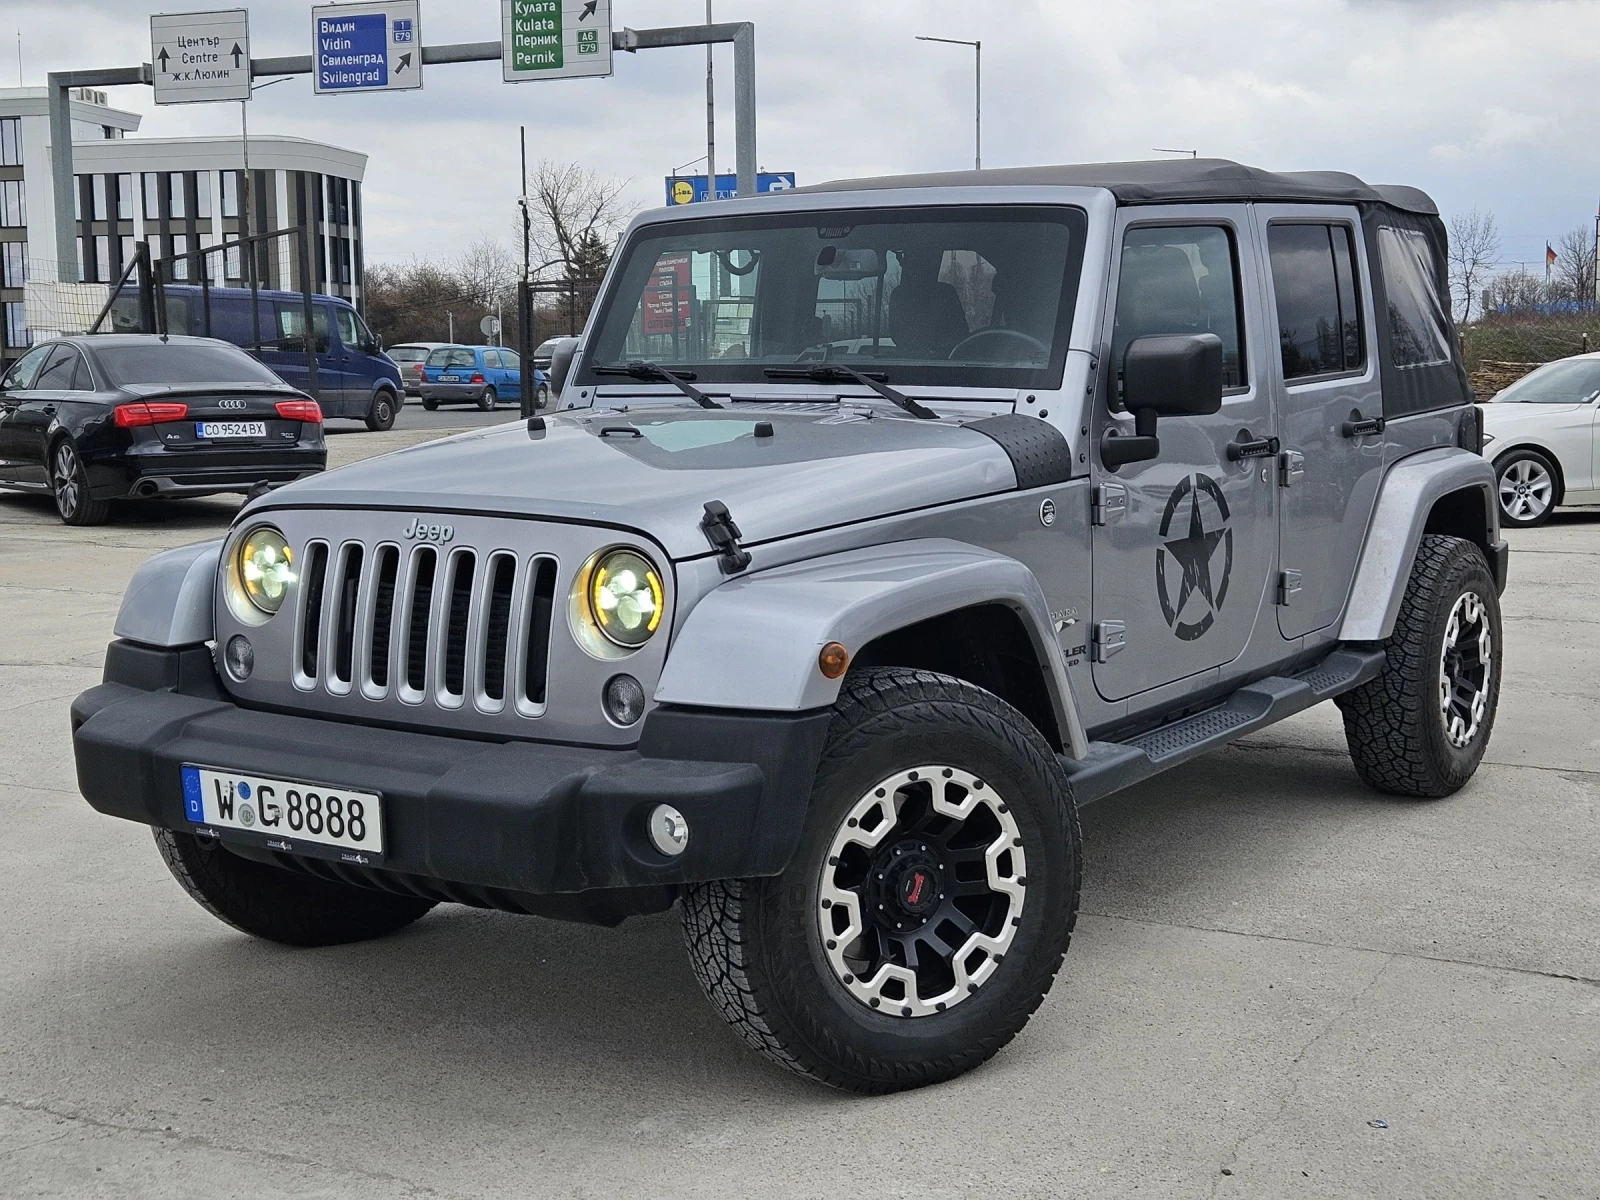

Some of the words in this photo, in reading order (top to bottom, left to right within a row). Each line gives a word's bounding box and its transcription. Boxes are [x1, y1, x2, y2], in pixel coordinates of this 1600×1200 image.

[515, 1, 556, 16] Кулата
[320, 20, 356, 34] Видин
[401, 21, 405, 30] 1
[515, 18, 555, 32] Kulata
[177, 35, 220, 48] Център
[395, 31, 411, 41] E79
[515, 34, 559, 48] Перник
[581, 31, 594, 41] A6
[321, 38, 352, 51] Vidin
[580, 43, 596, 53] E79
[181, 52, 219, 65] Centre
[320, 53, 385, 69] Свиленград
[516, 50, 556, 65] Pernik
[322, 69, 380, 85] Svilengrad
[402, 517, 455, 546] Jeep
[1063, 644, 1087, 658] LER
[190, 800, 199, 812] D
